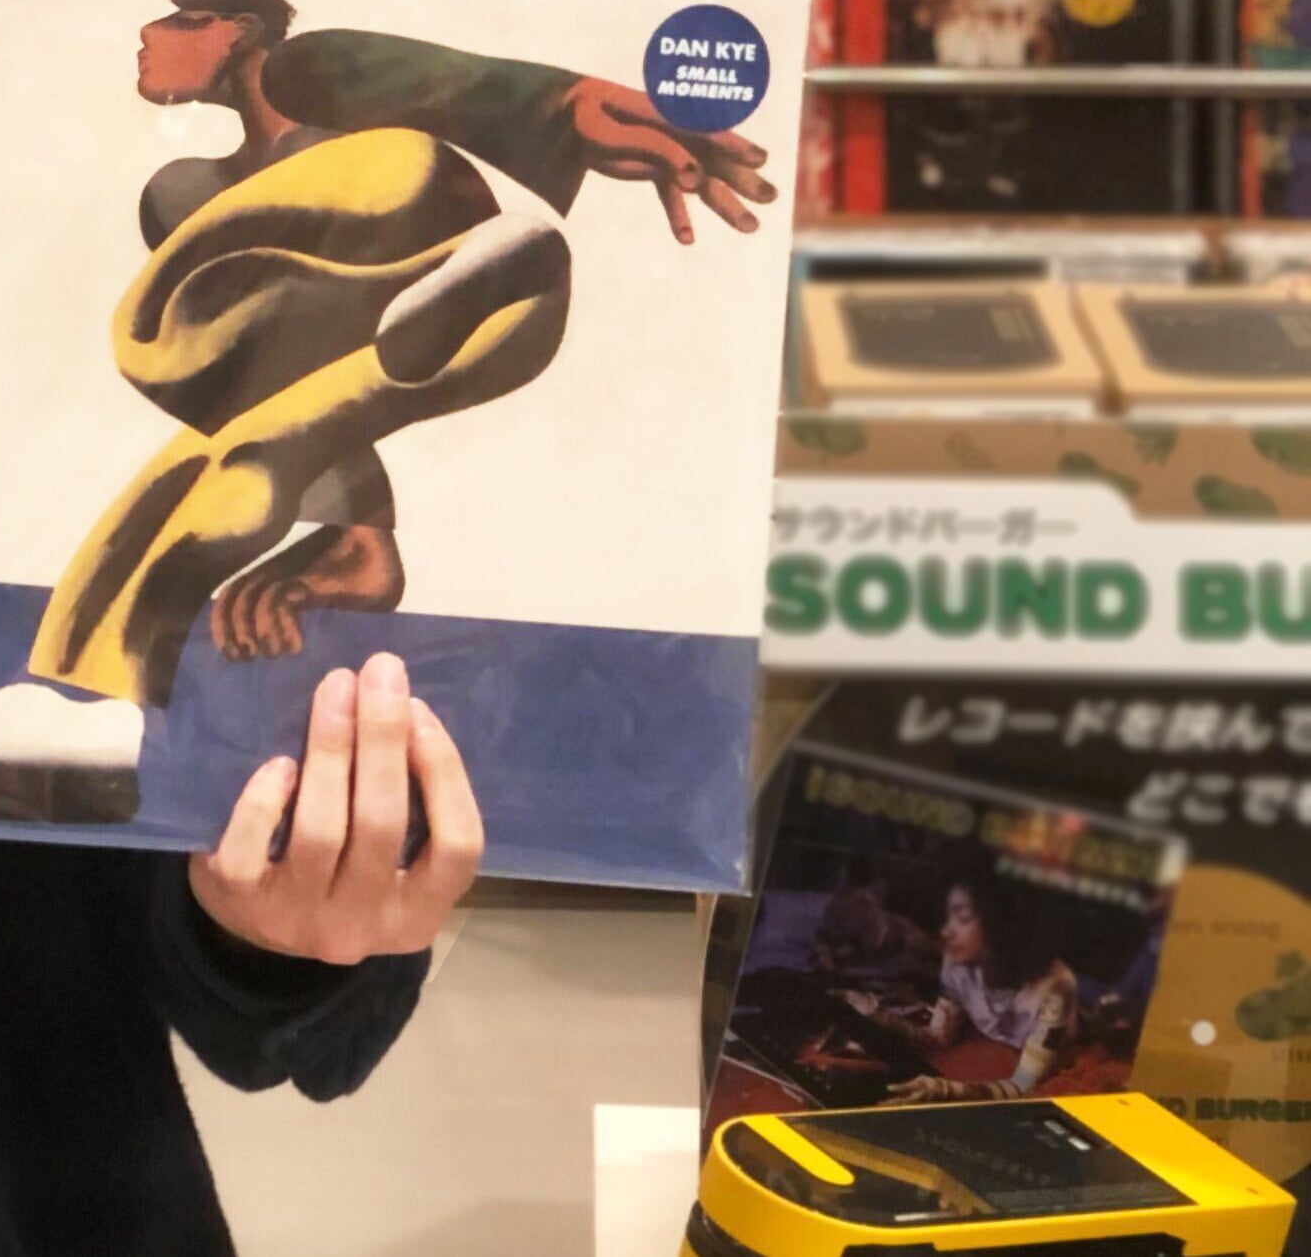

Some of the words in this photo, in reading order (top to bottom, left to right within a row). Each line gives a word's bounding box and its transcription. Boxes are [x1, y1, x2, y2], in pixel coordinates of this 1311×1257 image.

[659, 37, 709, 59] DAN
[715, 41, 757, 62] KYE
[676, 65, 738, 84] SMALL
[656, 80, 754, 102] MOMENTS
[763, 553, 1150, 641] SOUND
[1127, 771, 1311, 826] どこで
